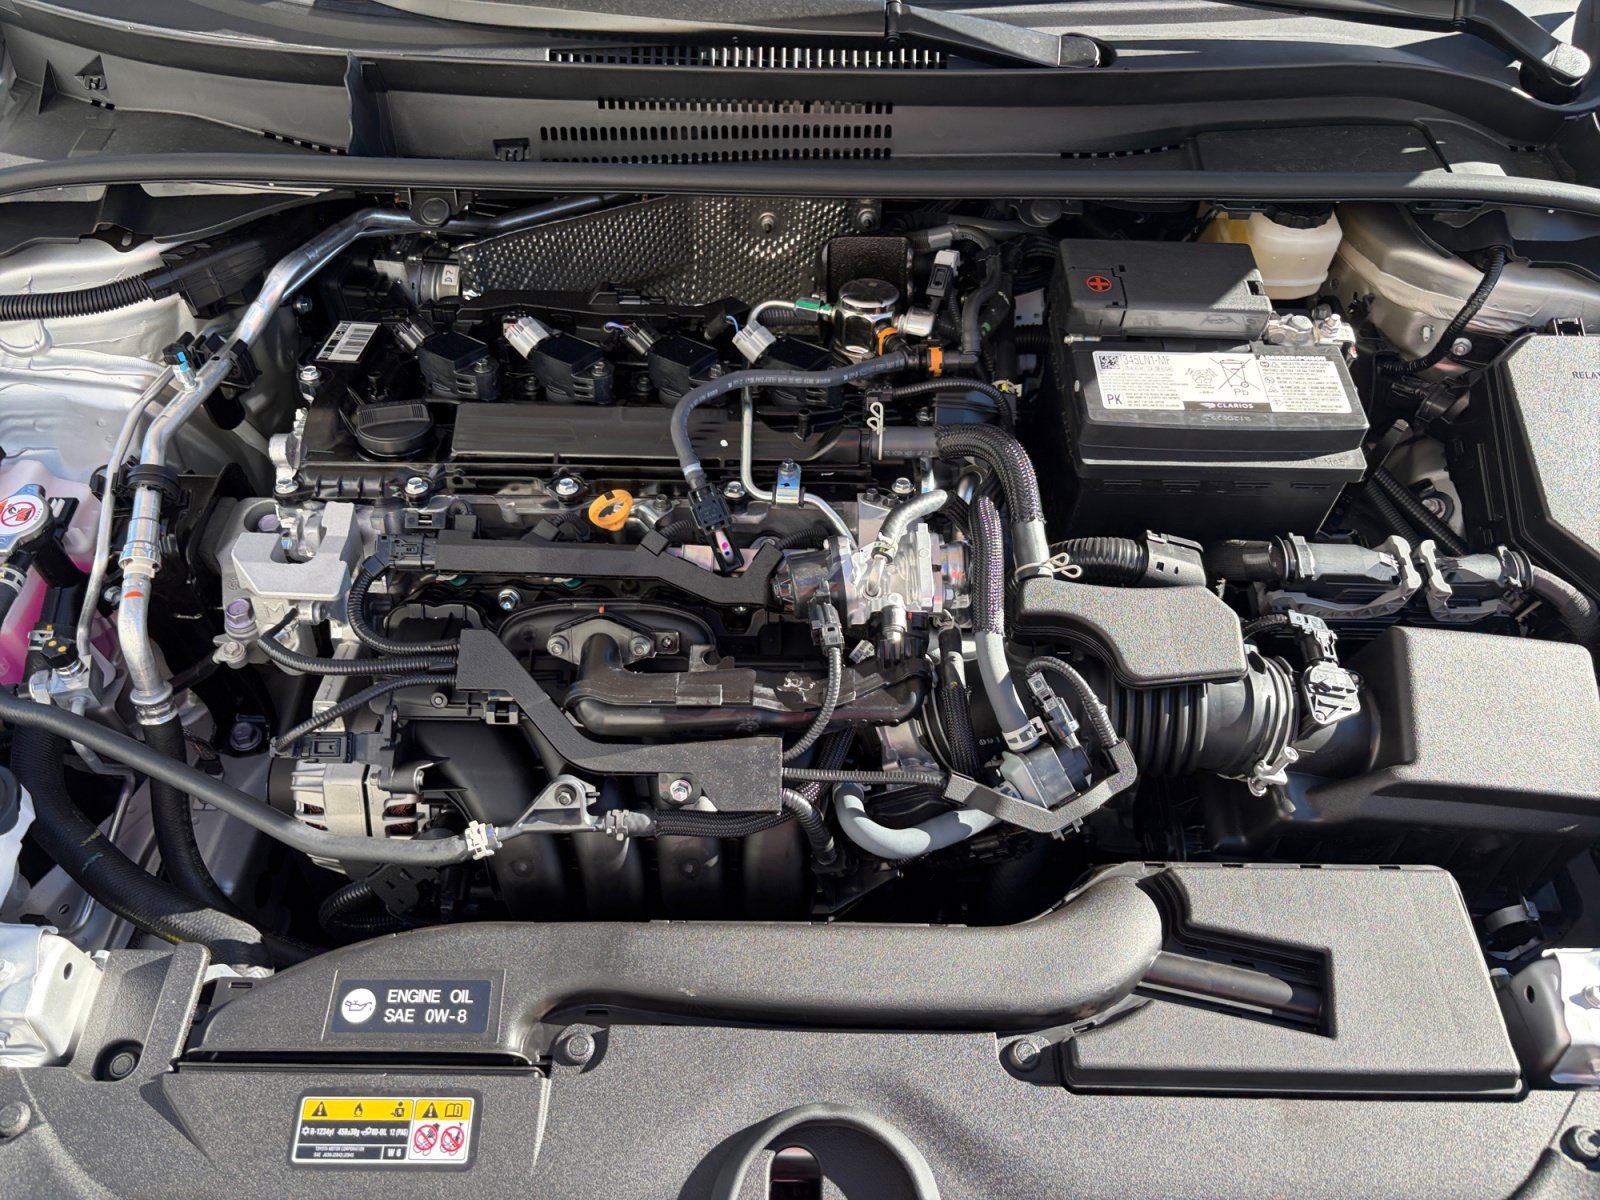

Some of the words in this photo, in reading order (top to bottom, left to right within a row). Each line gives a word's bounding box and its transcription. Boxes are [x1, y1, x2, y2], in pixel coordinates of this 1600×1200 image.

[1107, 394, 1122, 405] PK
[387, 989, 442, 1003] ENGINE
[450, 989, 474, 1003] OIL
[383, 1009, 415, 1023] SAE
[425, 1009, 468, 1023] 0W-8
